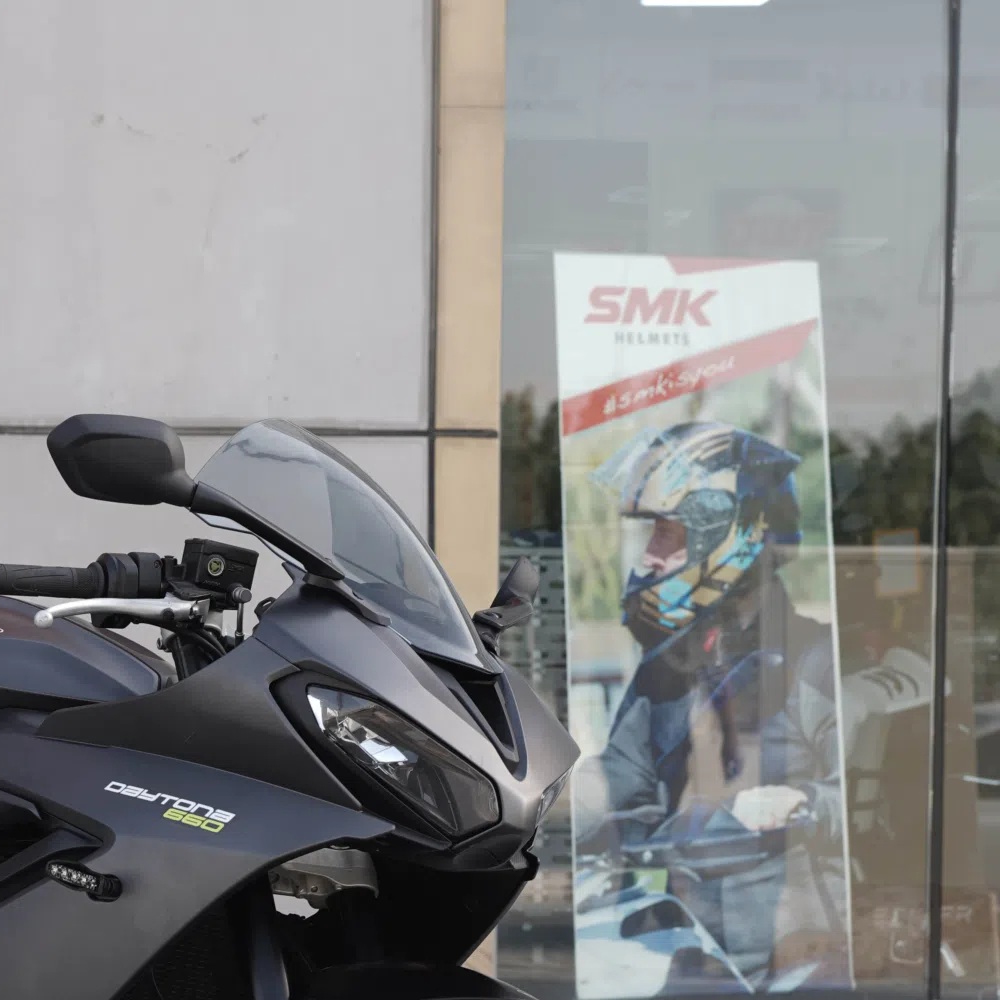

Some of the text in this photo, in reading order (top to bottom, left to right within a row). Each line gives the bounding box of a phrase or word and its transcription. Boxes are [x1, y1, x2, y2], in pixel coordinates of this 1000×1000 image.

[583, 285, 718, 327] SMK
[614, 331, 690, 346] HELMETS
[162, 807, 225, 833] 660
